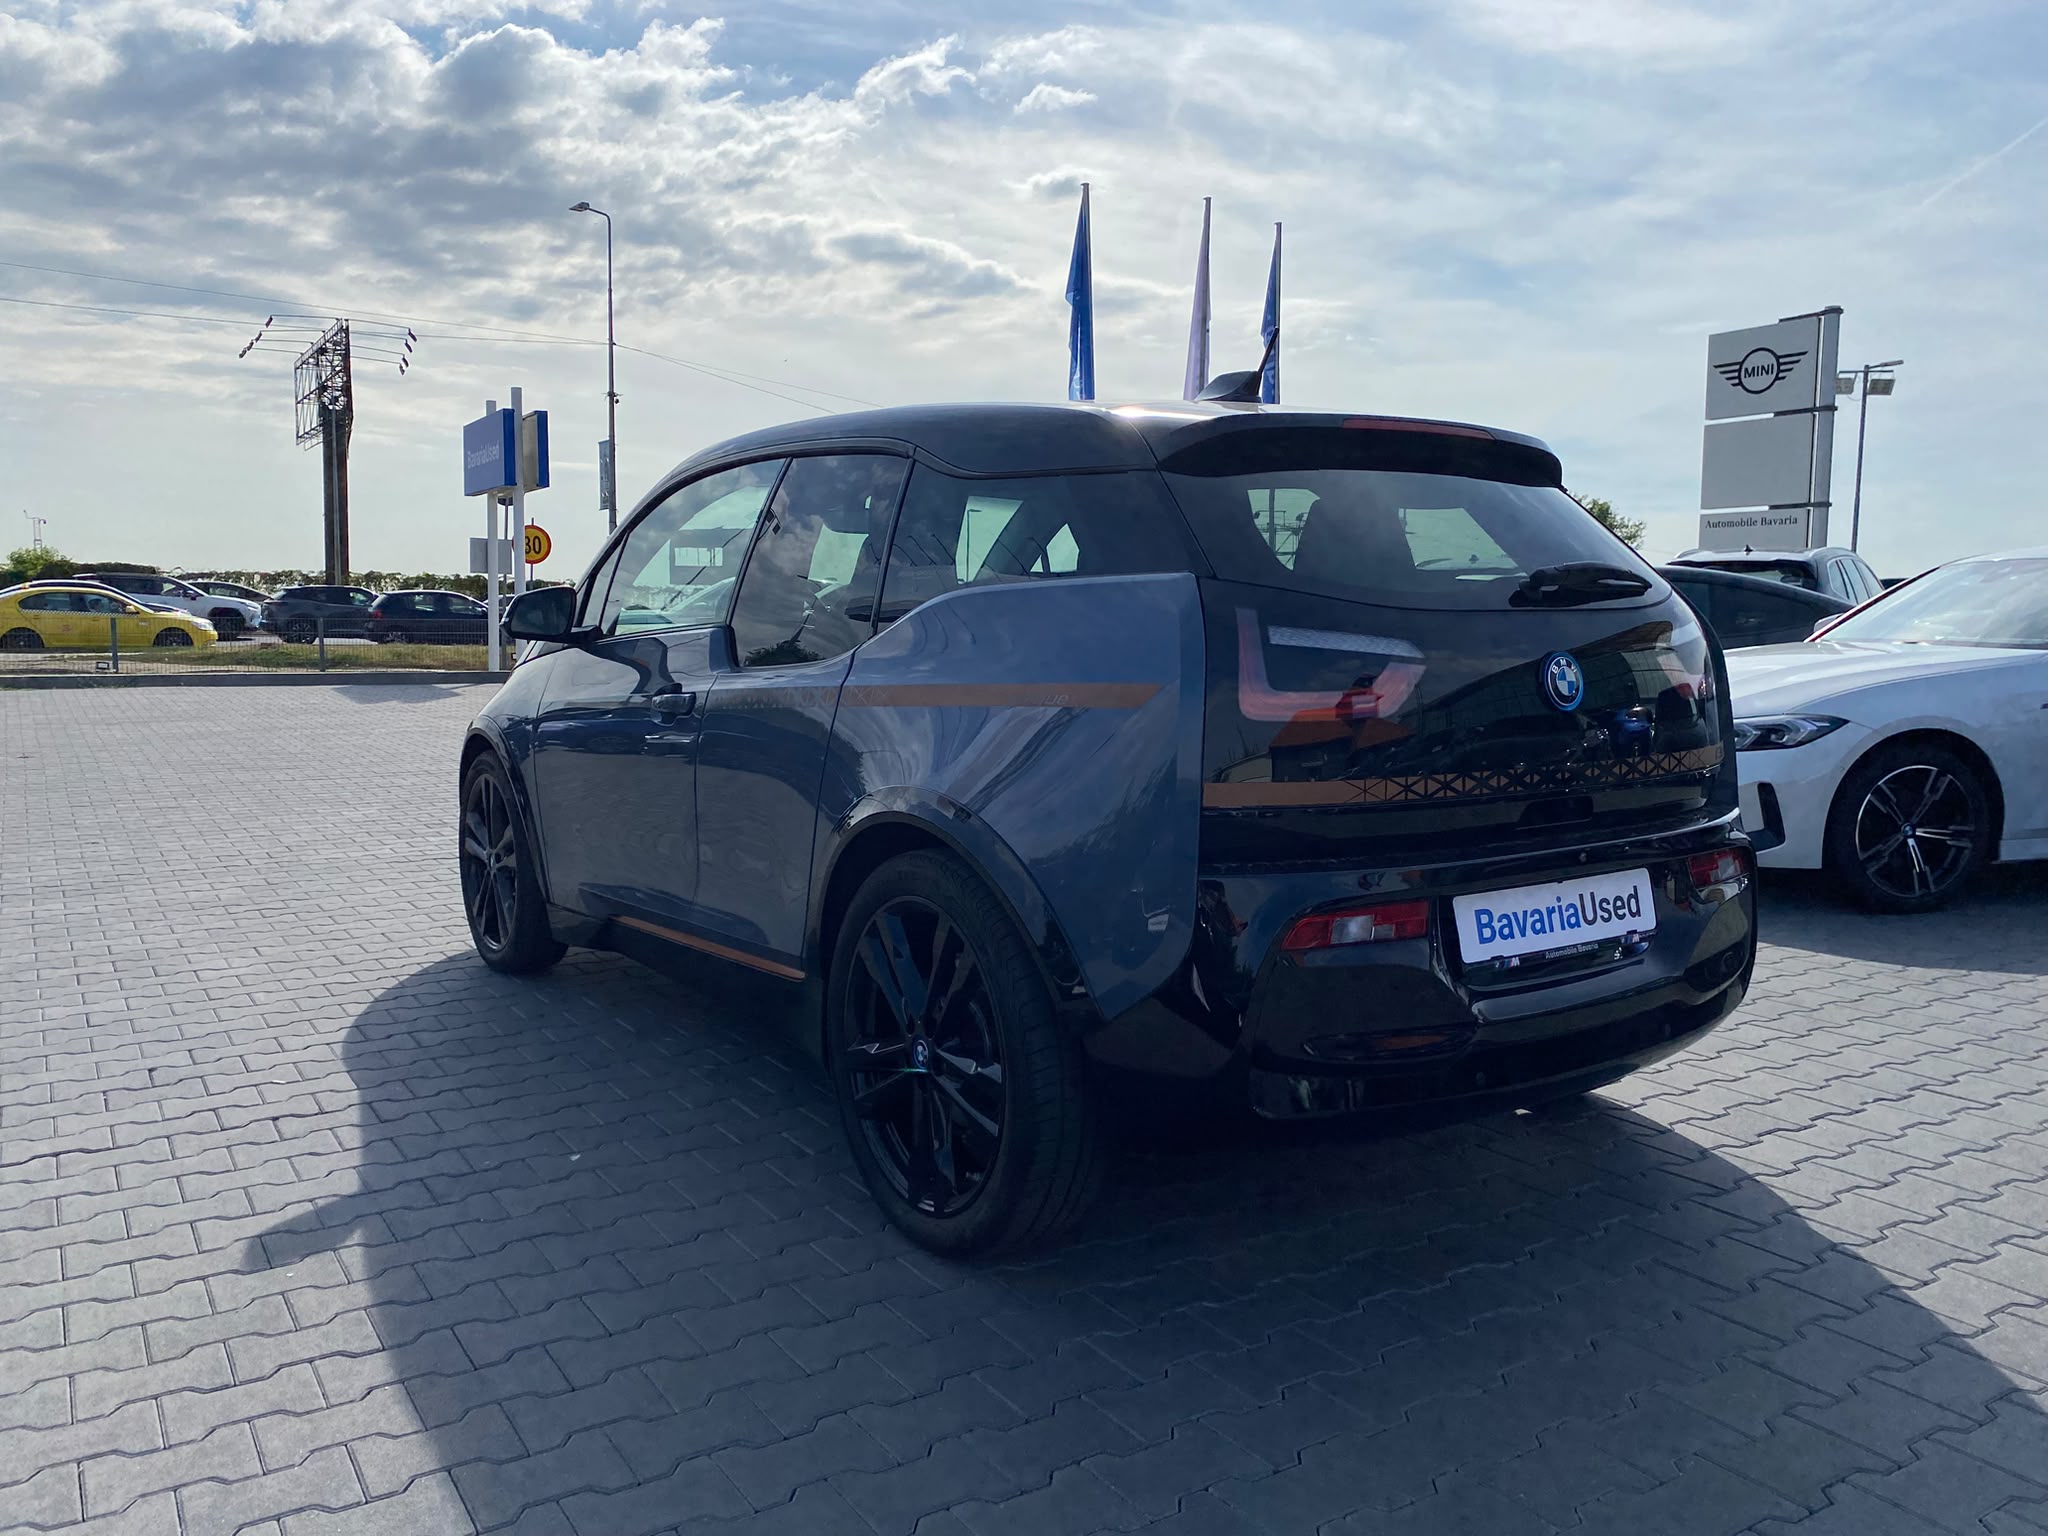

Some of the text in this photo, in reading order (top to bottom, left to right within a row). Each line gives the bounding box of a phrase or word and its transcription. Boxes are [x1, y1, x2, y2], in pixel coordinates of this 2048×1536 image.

[1743, 363, 1775, 379] MINI
[1705, 514, 1798, 530] Automobile Bavaria
[1473, 885, 1643, 945] BavariaUsed
